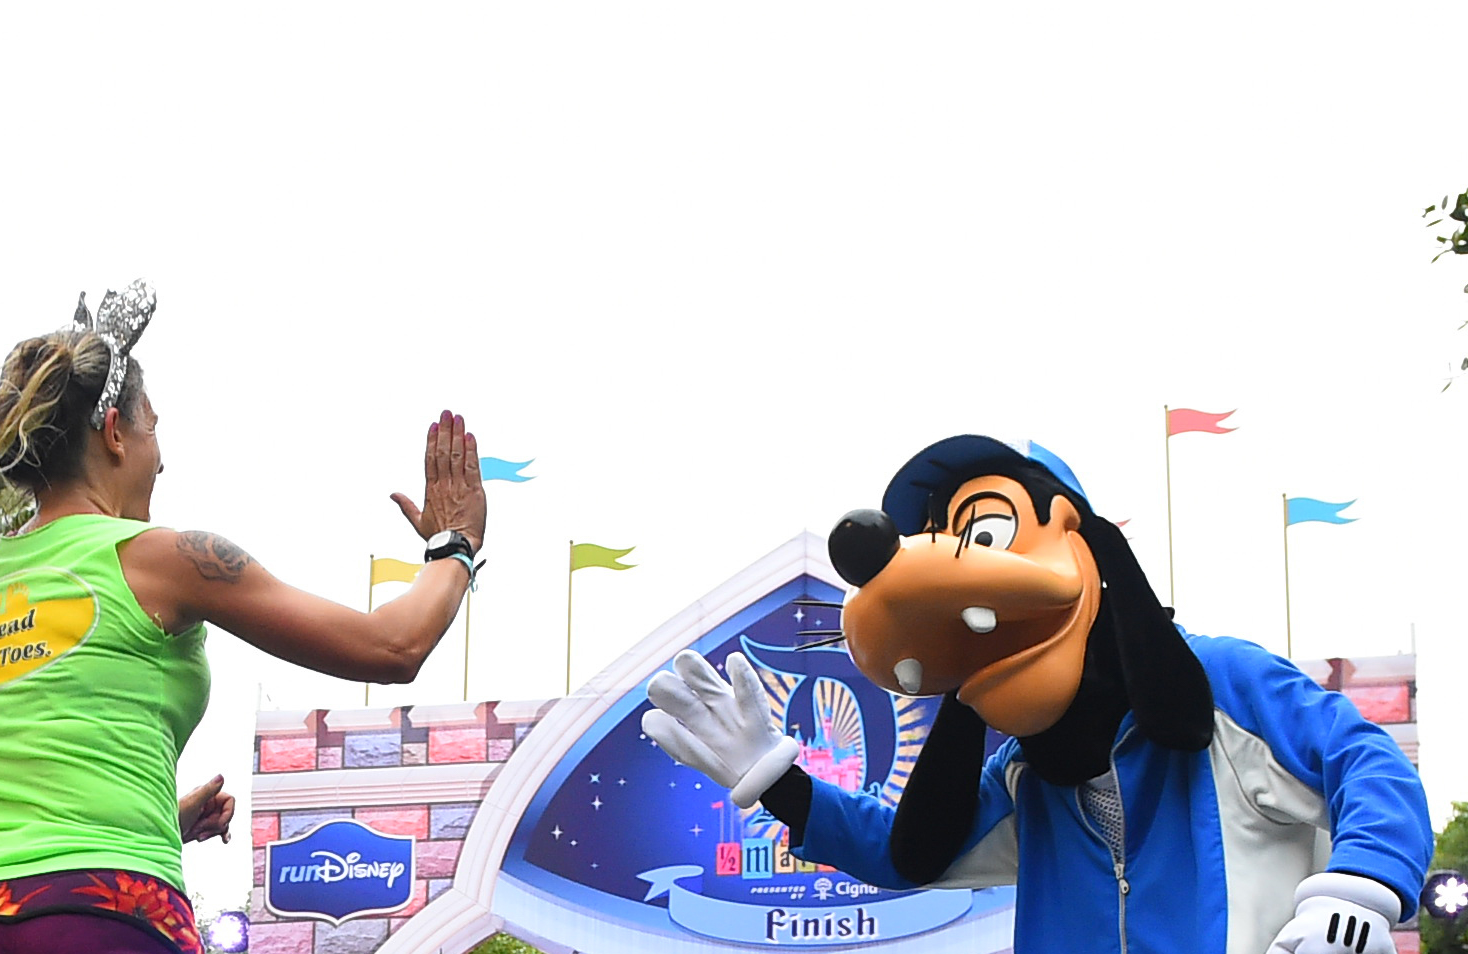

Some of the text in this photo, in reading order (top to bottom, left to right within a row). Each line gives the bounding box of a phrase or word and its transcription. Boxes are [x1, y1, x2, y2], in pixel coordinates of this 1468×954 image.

[279, 850, 405, 888] runDisney
[750, 885, 806, 894] PRESENTED
[766, 907, 875, 940] Finish
